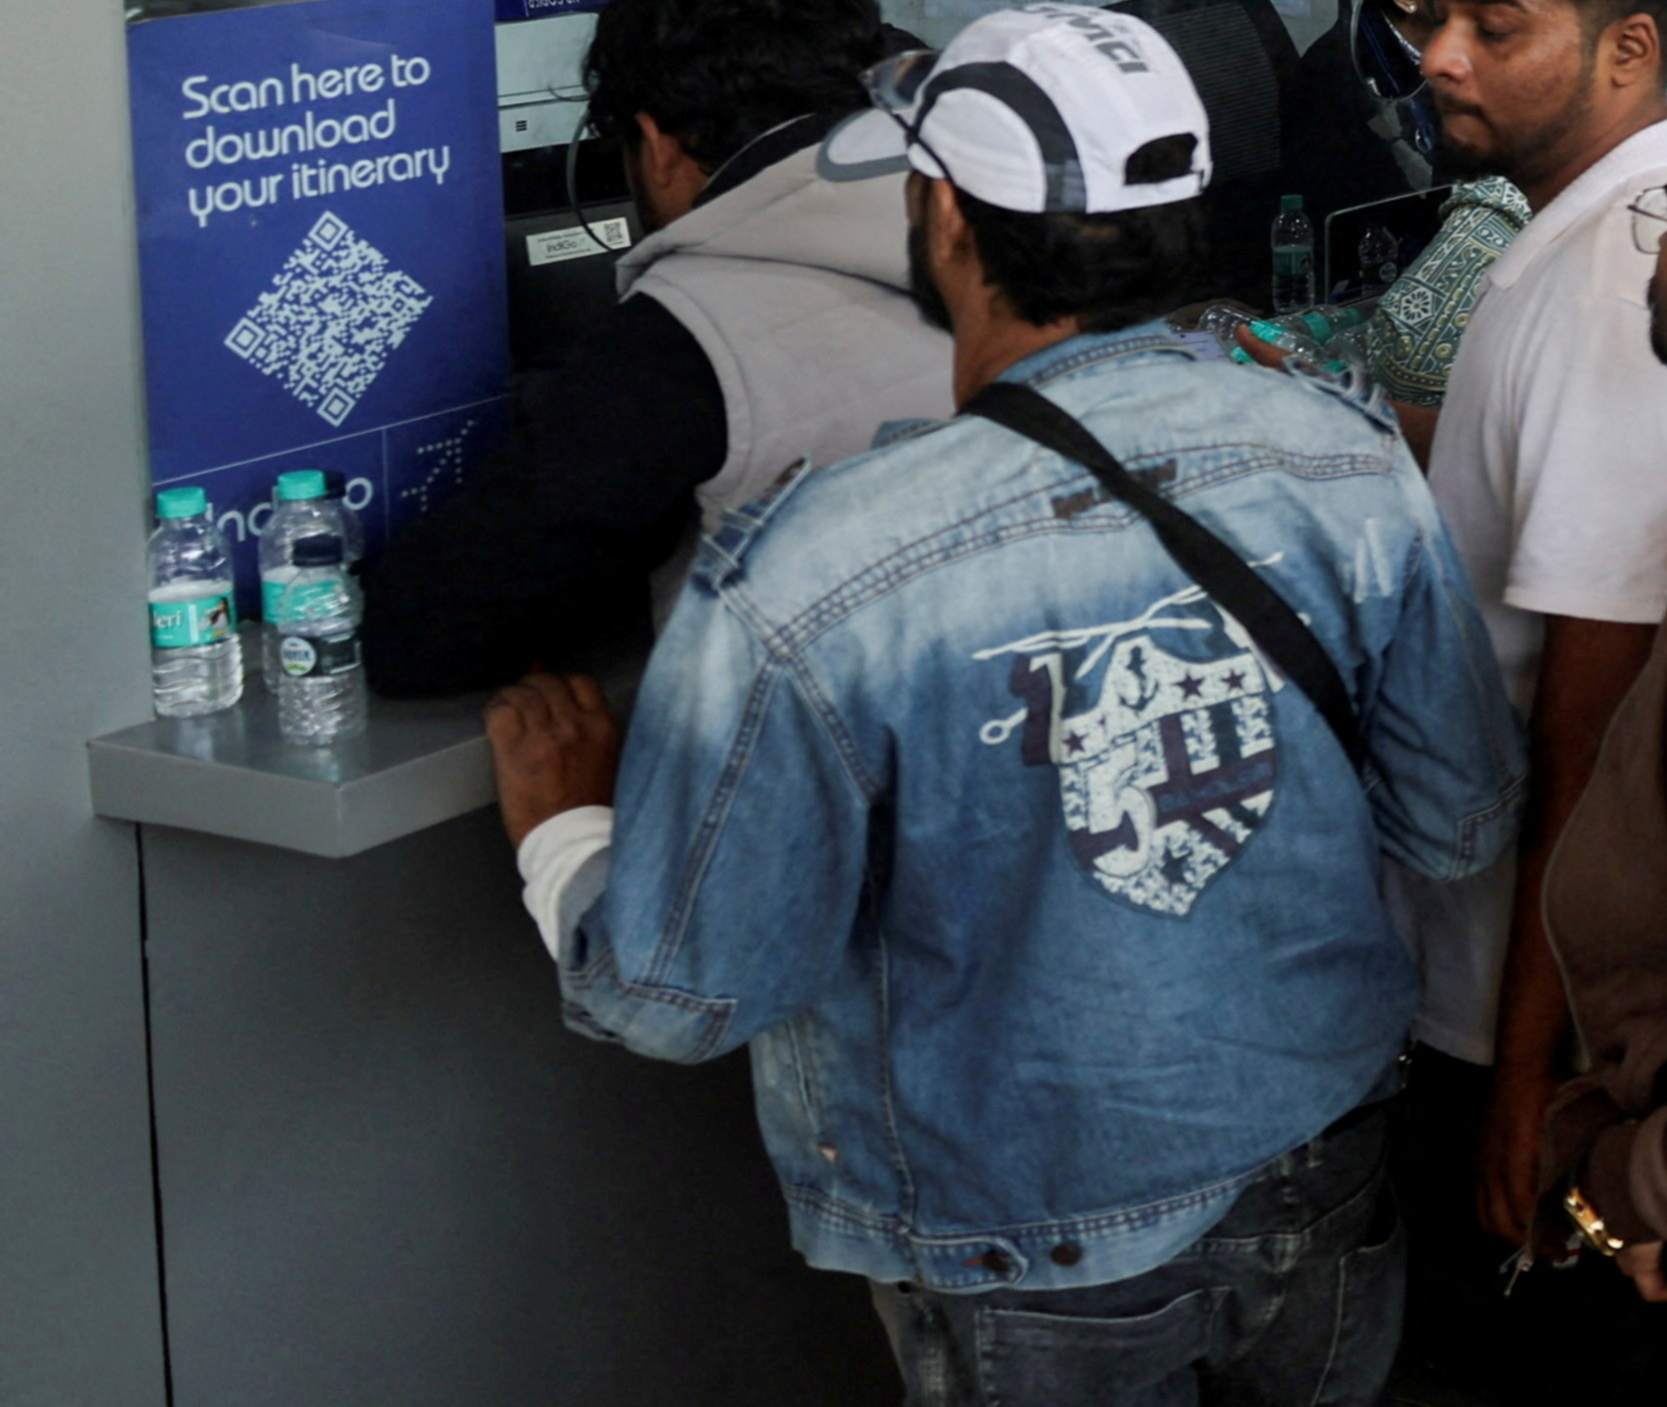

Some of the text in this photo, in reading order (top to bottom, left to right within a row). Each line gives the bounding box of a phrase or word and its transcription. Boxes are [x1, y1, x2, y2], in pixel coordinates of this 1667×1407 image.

[182, 54, 430, 119] Scan here to
[185, 98, 395, 168] download
[188, 145, 449, 228] your itinerary
